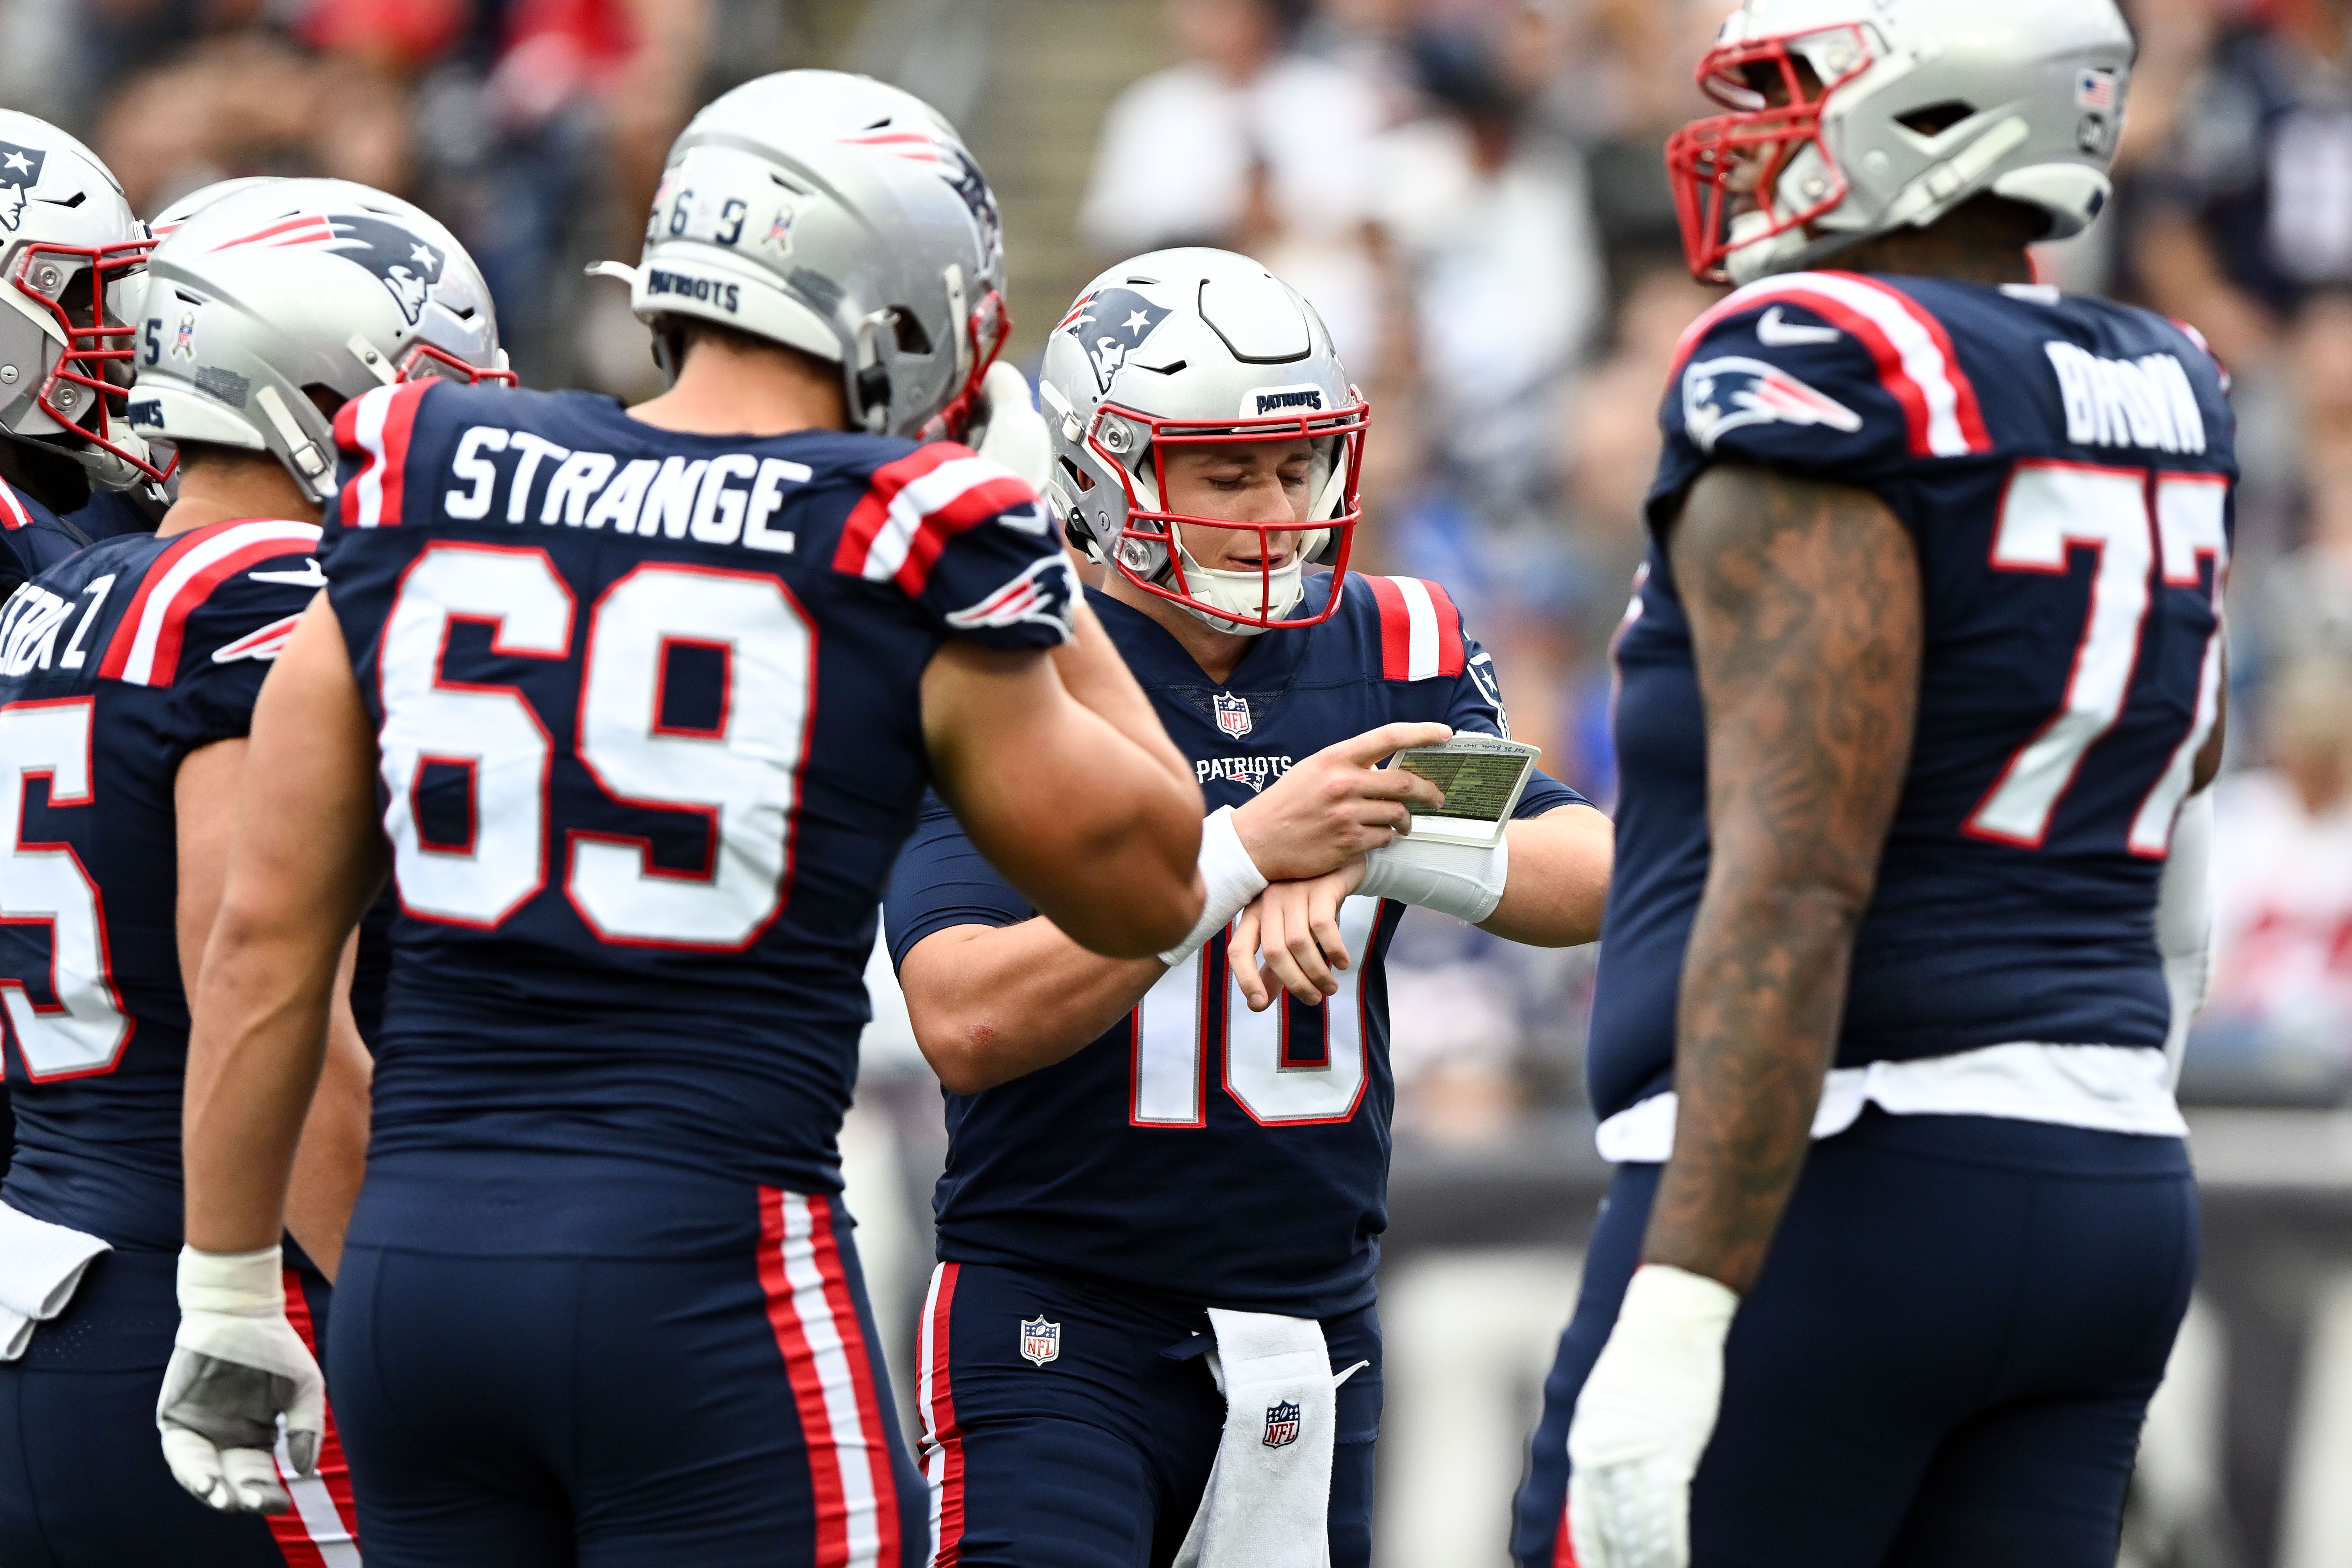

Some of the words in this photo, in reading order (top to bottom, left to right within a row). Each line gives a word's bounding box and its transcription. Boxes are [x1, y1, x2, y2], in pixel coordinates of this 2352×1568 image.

[1256, 390, 1322, 415] PATRIOTS
[444, 425, 812, 554] STRANGE
[1959, 456, 2230, 861] 77
[1222, 711, 1246, 730] NFL
[376, 539, 820, 953] 69
[1196, 756, 1292, 784] PATRIOTS
[1027, 1338, 1053, 1357] NFL
[1264, 1422, 1295, 1444] NFL
